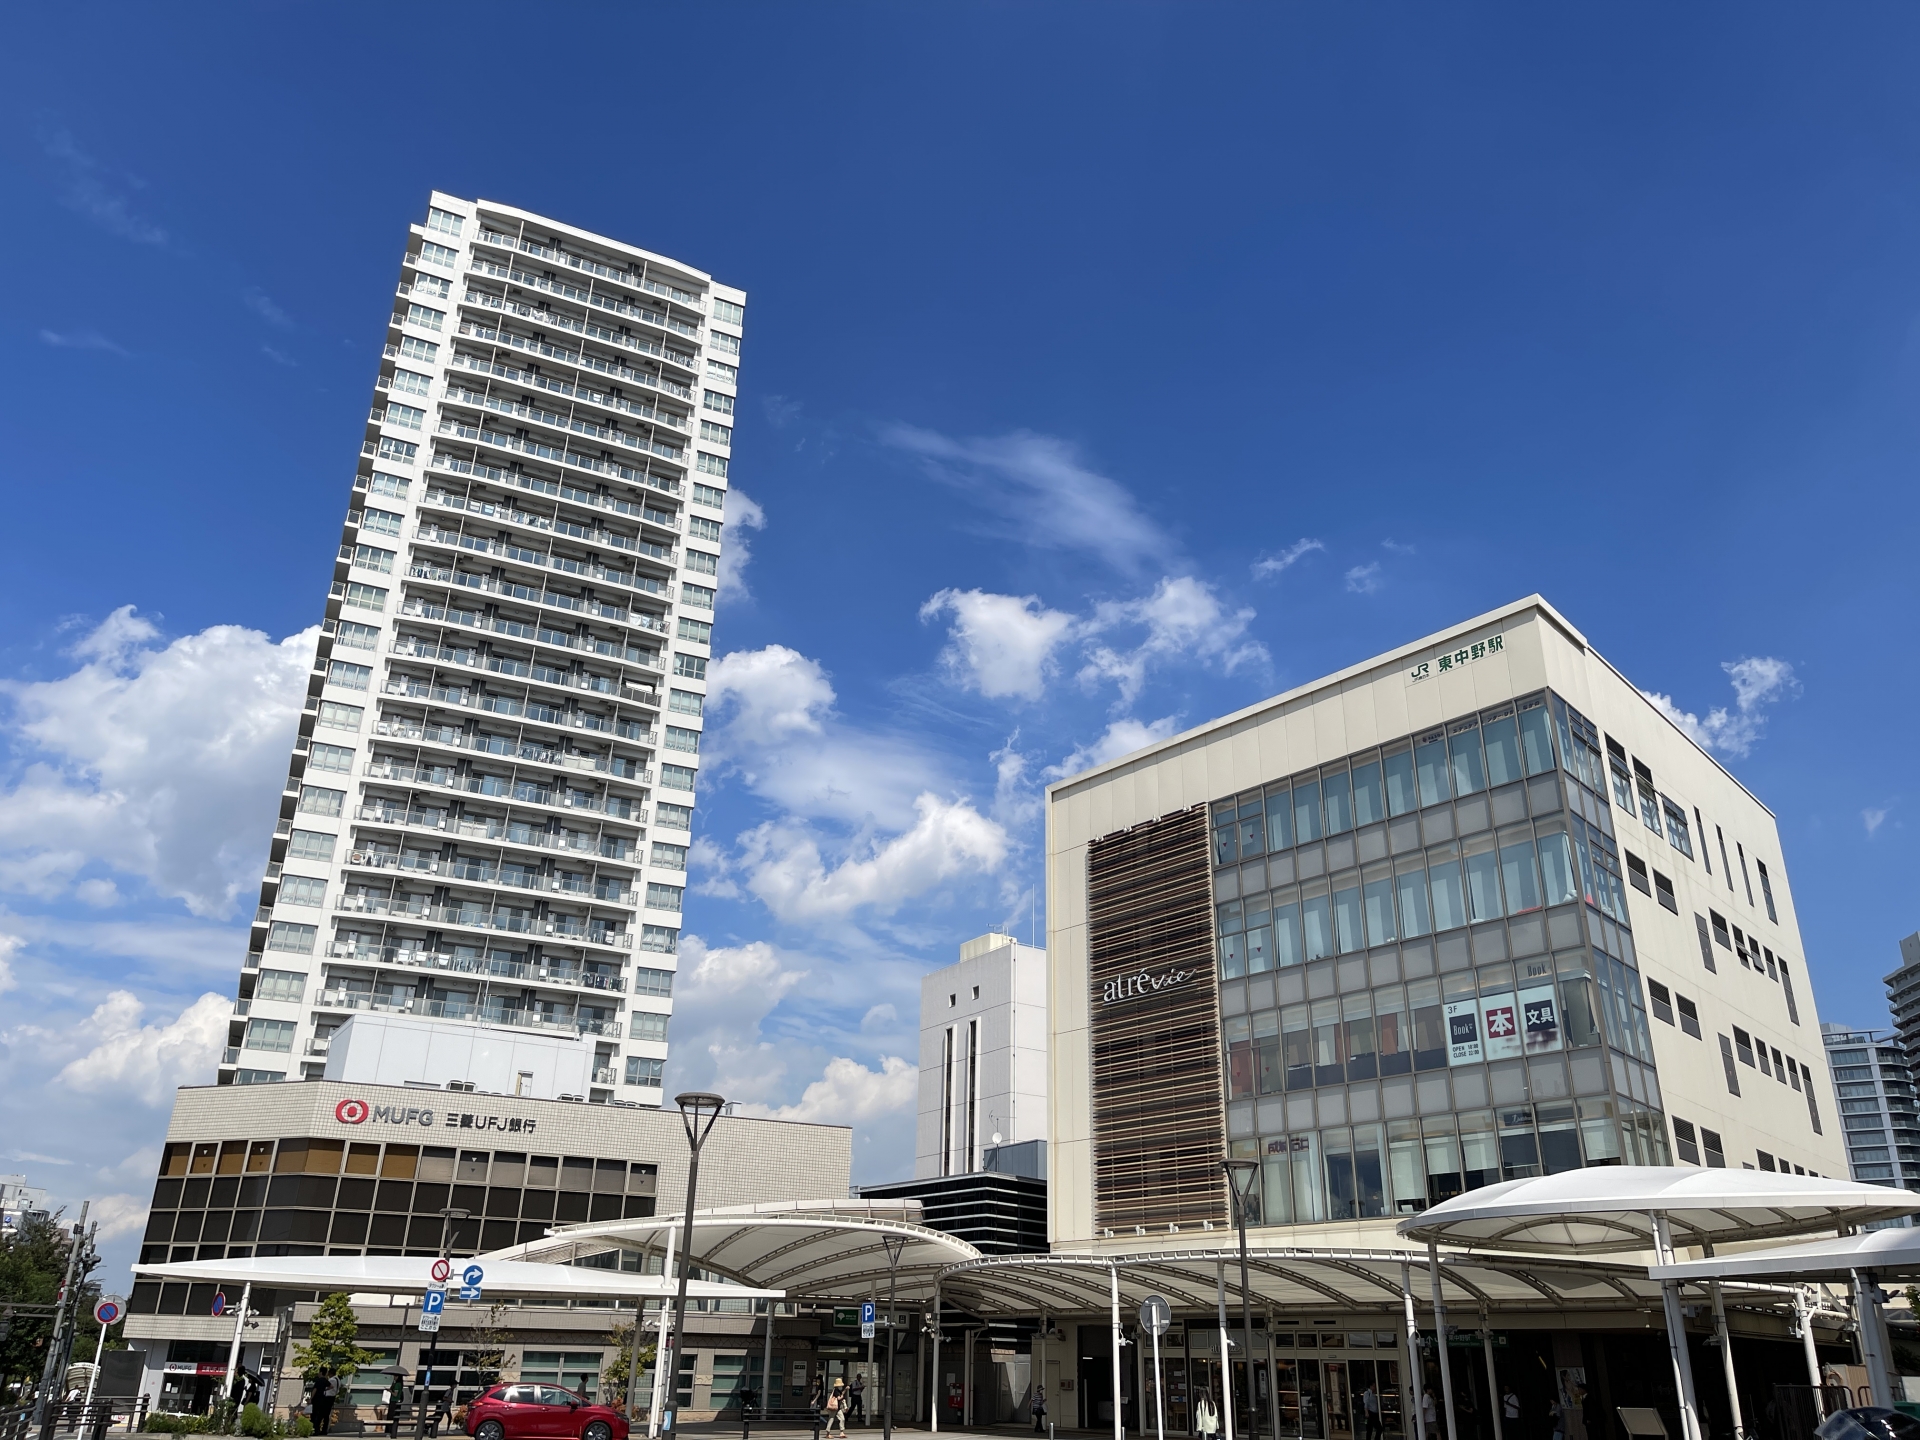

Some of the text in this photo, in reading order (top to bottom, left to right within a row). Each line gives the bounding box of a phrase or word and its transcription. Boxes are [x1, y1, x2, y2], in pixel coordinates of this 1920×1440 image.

[1438, 635, 1504, 672] 東中野駅
[1411, 663, 1429, 678] JR
[1527, 963, 1547, 977] Book
[1448, 1005, 1457, 1014] 3F
[1526, 1007, 1554, 1026] 文具
[1489, 1010, 1513, 1035] 本
[1453, 1051, 1467, 1059] CLOSE
[373, 1105, 434, 1126] MUFG
[445, 1112, 537, 1134] 三菱UFJ銀行
[428, 1292, 441, 1311] P
[865, 1305, 873, 1321] P
